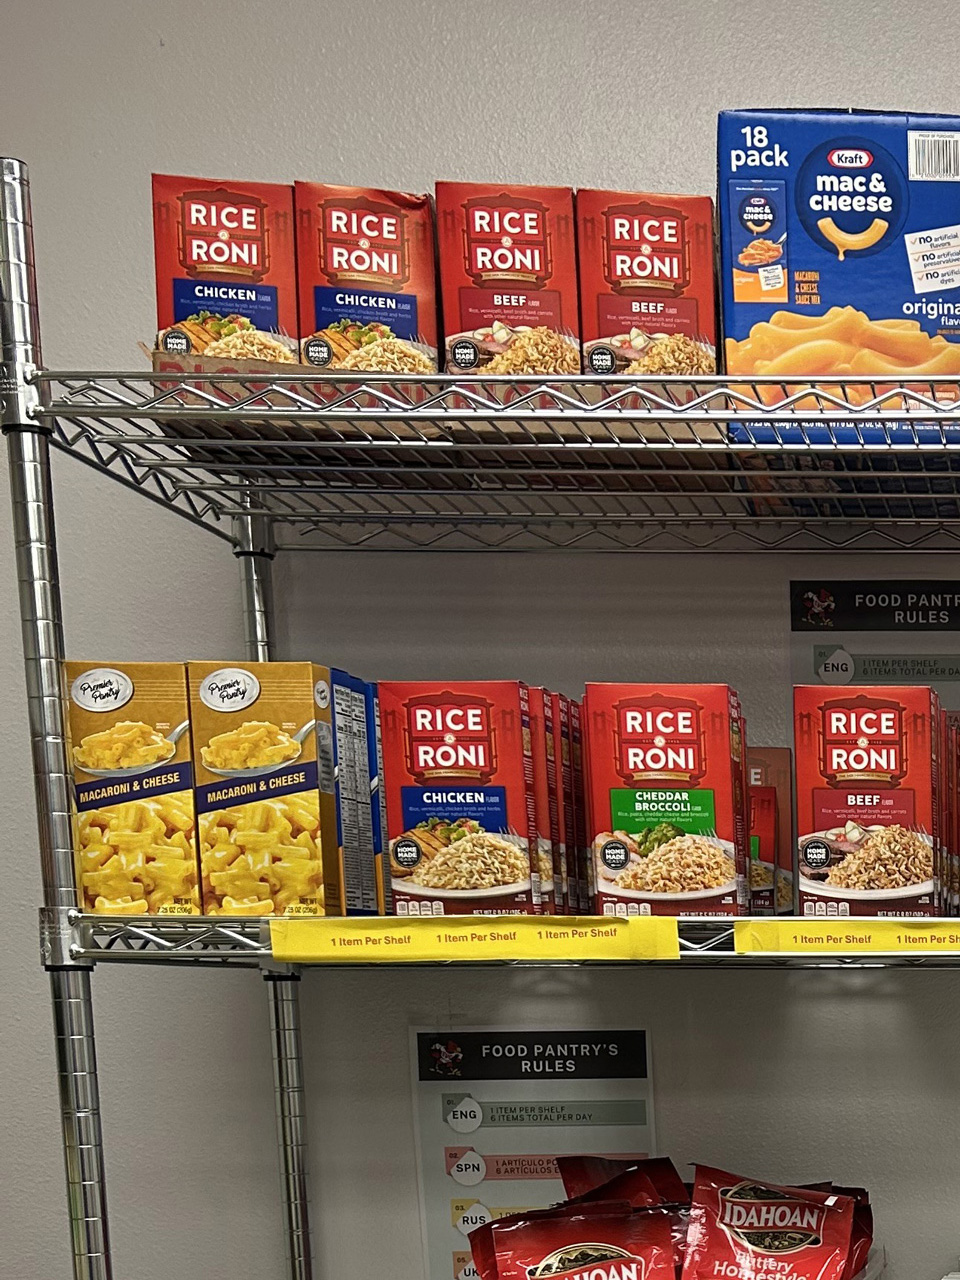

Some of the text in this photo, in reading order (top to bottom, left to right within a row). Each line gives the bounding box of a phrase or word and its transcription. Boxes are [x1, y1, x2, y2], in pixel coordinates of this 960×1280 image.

[741, 126, 768, 147] 18
[731, 144, 788, 171] pack
[837, 153, 863, 164] Kraft
[817, 173, 886, 192] mac &
[190, 203, 257, 230] RICE
[474, 210, 538, 235] RICE
[918, 233, 958, 244] no artificial
[930, 241, 951, 249] flavors
[191, 239, 257, 265] RONI
[476, 247, 540, 271] RONI
[925, 271, 939, 280] no
[940, 276, 954, 285] dyes
[194, 285, 256, 301] CHICKEN
[493, 295, 526, 306] BEEF
[855, 594, 901, 607] FOOD
[895, 611, 949, 623] RULES
[824, 663, 848, 672] ENG
[80, 679, 113, 694] Premier
[92, 687, 120, 702] Pantry
[626, 711, 693, 733] RICE
[628, 748, 695, 769] RONI
[79, 773, 180, 803] MACARONI & CHEESE
[635, 792, 689, 801] CHEDDAR
[635, 802, 690, 812] BROCCOLI
[332, 935, 411, 946] 1 Item Per Shelf
[482, 1044, 618, 1057] FOOD PANTRY'S
[521, 1060, 576, 1072] RULES
[452, 1110, 476, 1119] ENG
[456, 1164, 480, 1172] SPN
[462, 1216, 486, 1224] RUS
[723, 1204, 819, 1229] IDAHOAN
